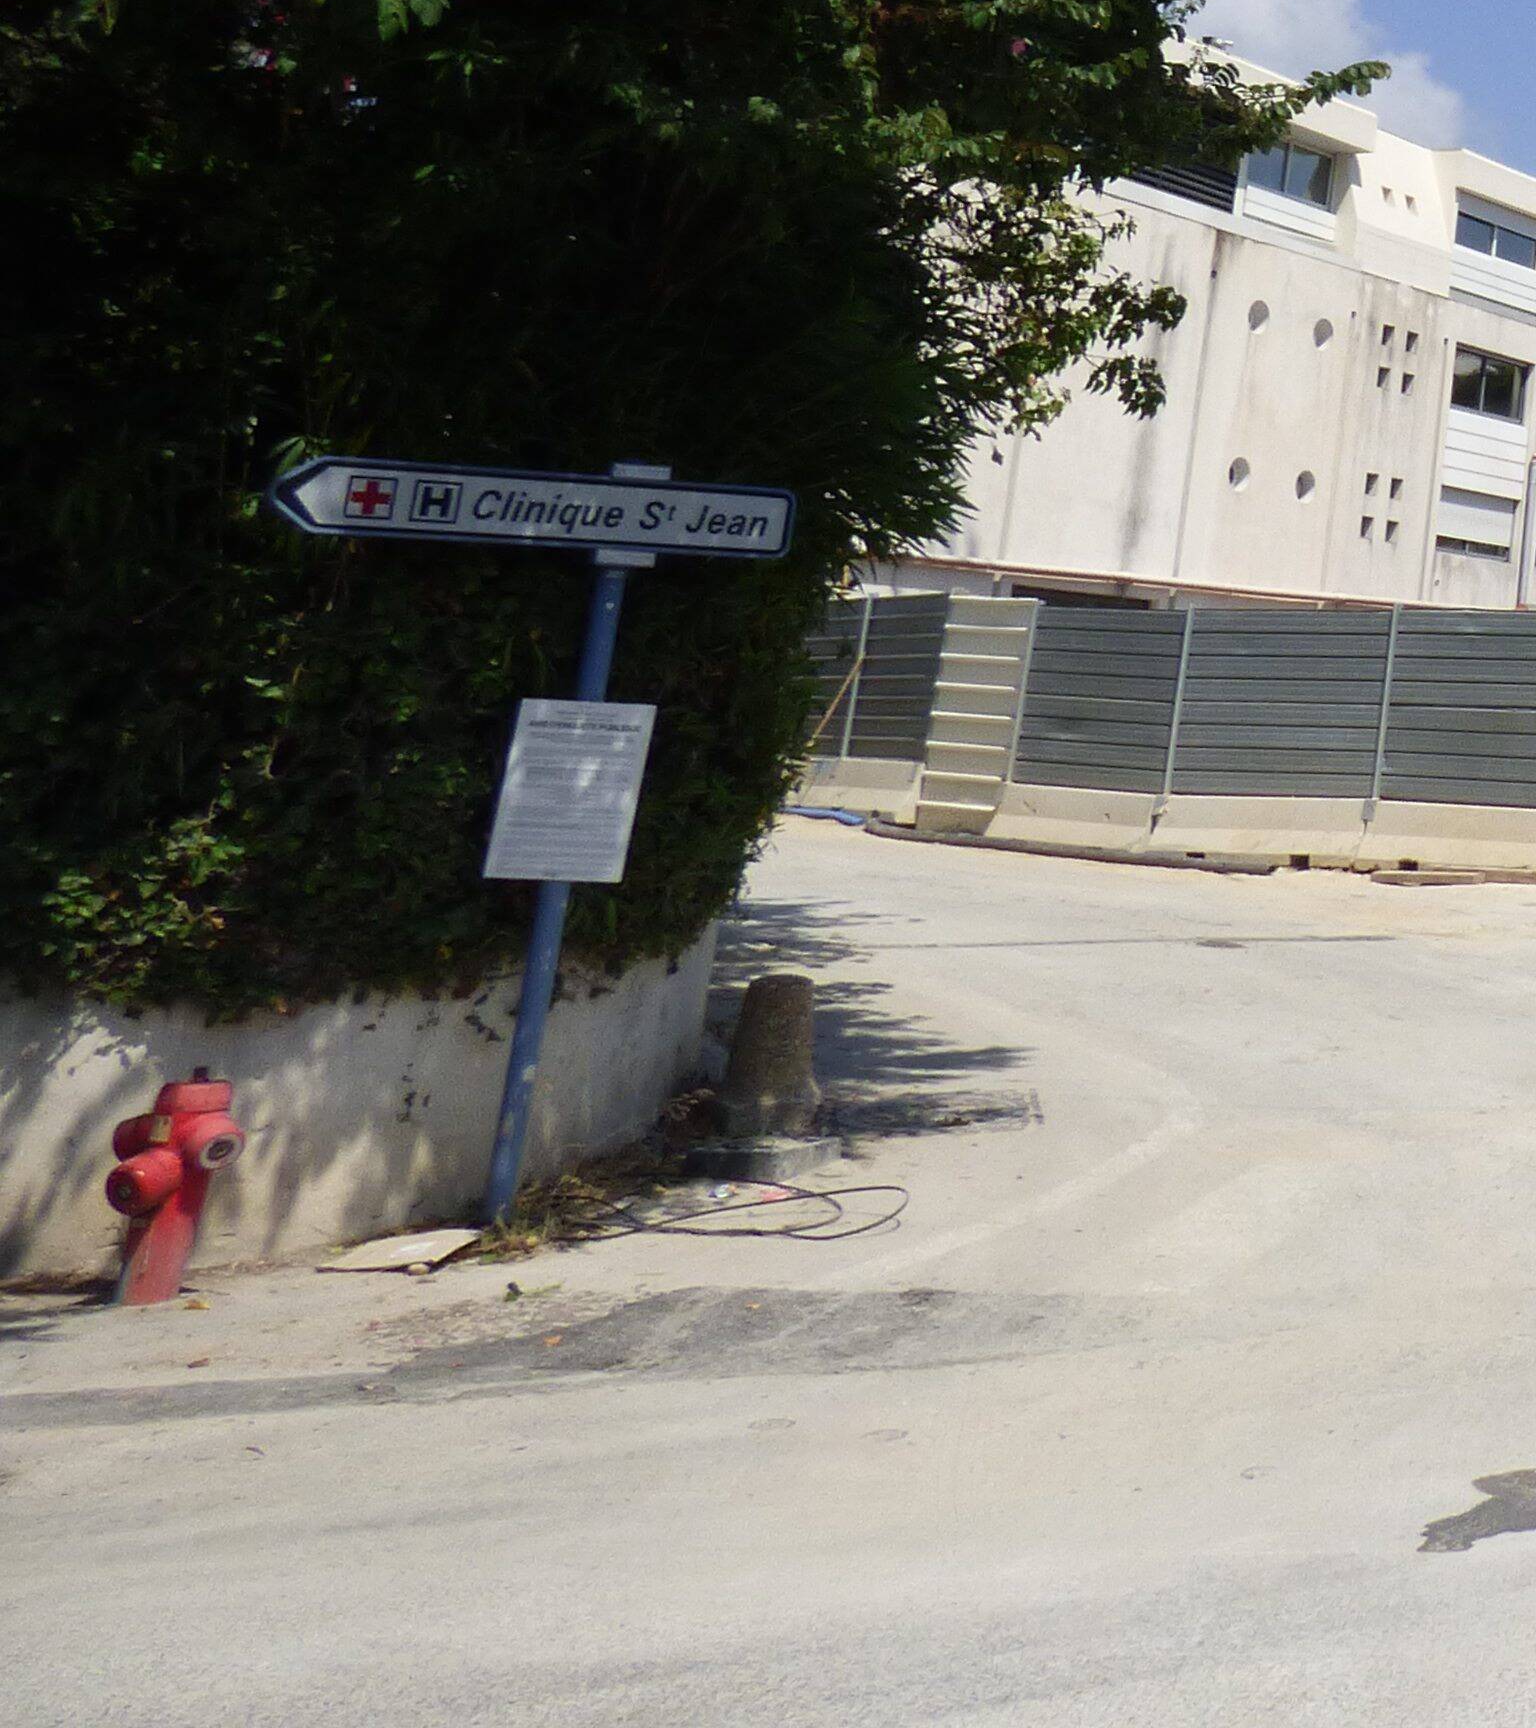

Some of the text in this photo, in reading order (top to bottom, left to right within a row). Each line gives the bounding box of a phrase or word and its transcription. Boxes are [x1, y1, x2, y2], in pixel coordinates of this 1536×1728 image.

[472, 490, 624, 535] Clinique
[639, 501, 677, 531] St
[686, 505, 770, 538] Jean
